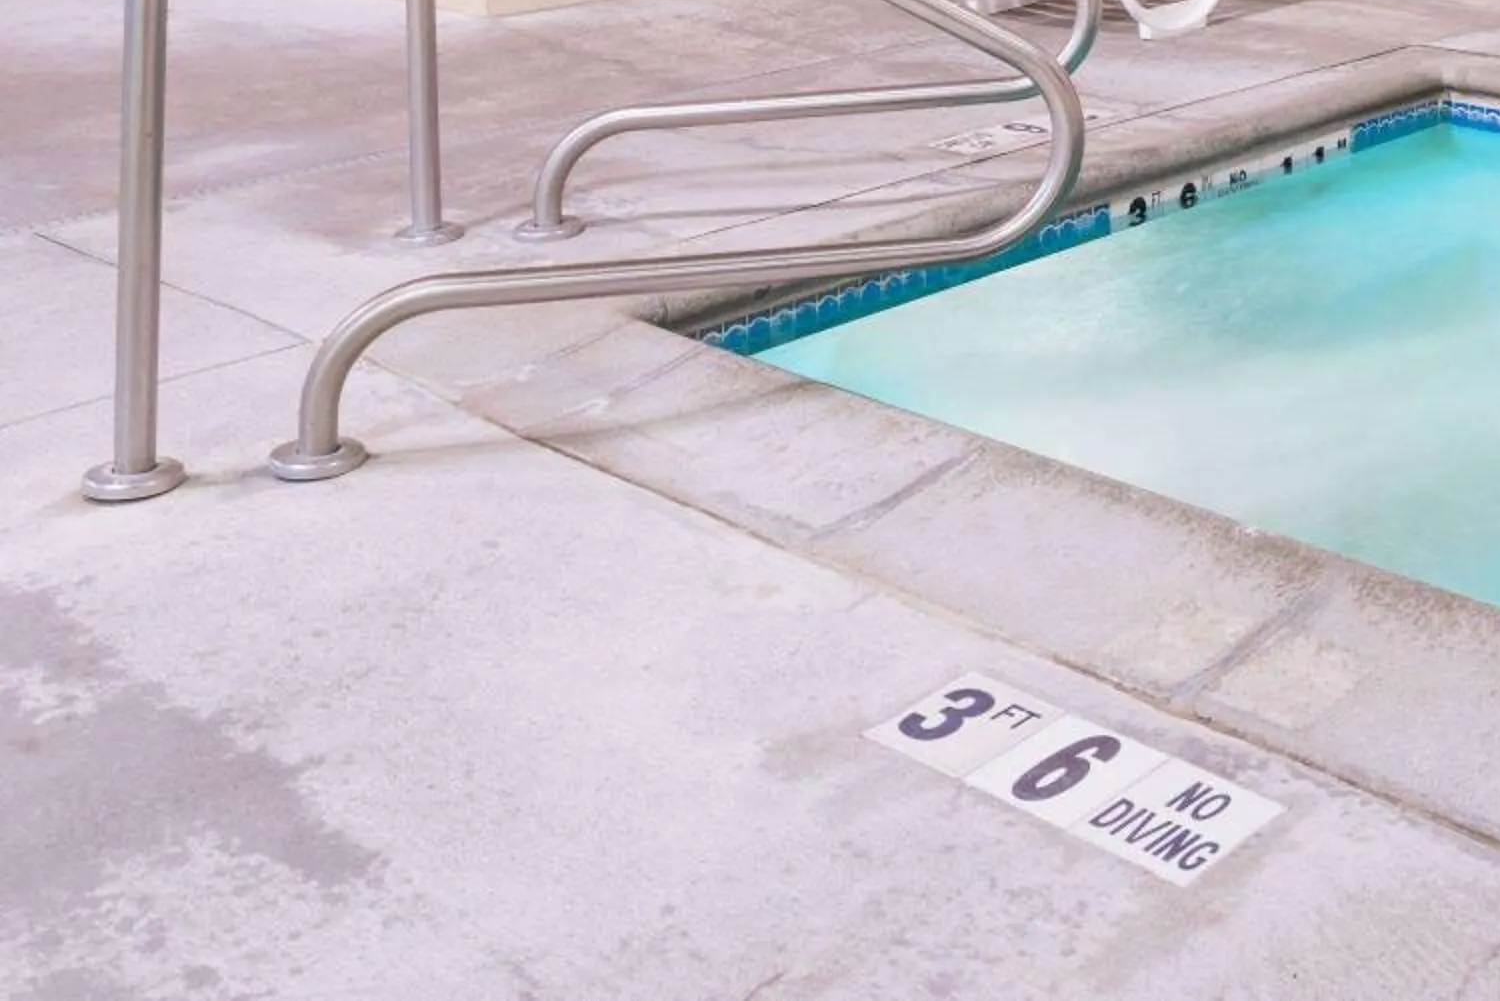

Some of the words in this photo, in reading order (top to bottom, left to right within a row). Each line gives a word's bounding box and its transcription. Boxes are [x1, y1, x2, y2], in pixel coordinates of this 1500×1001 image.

[1128, 196, 1147, 228] 3
[1179, 182, 1198, 210] 6
[898, 688, 996, 742] 3
[991, 703, 1043, 730] FT
[1011, 734, 1122, 803] 6
[1164, 781, 1232, 822] NO
[1088, 797, 1221, 871] DIVING
